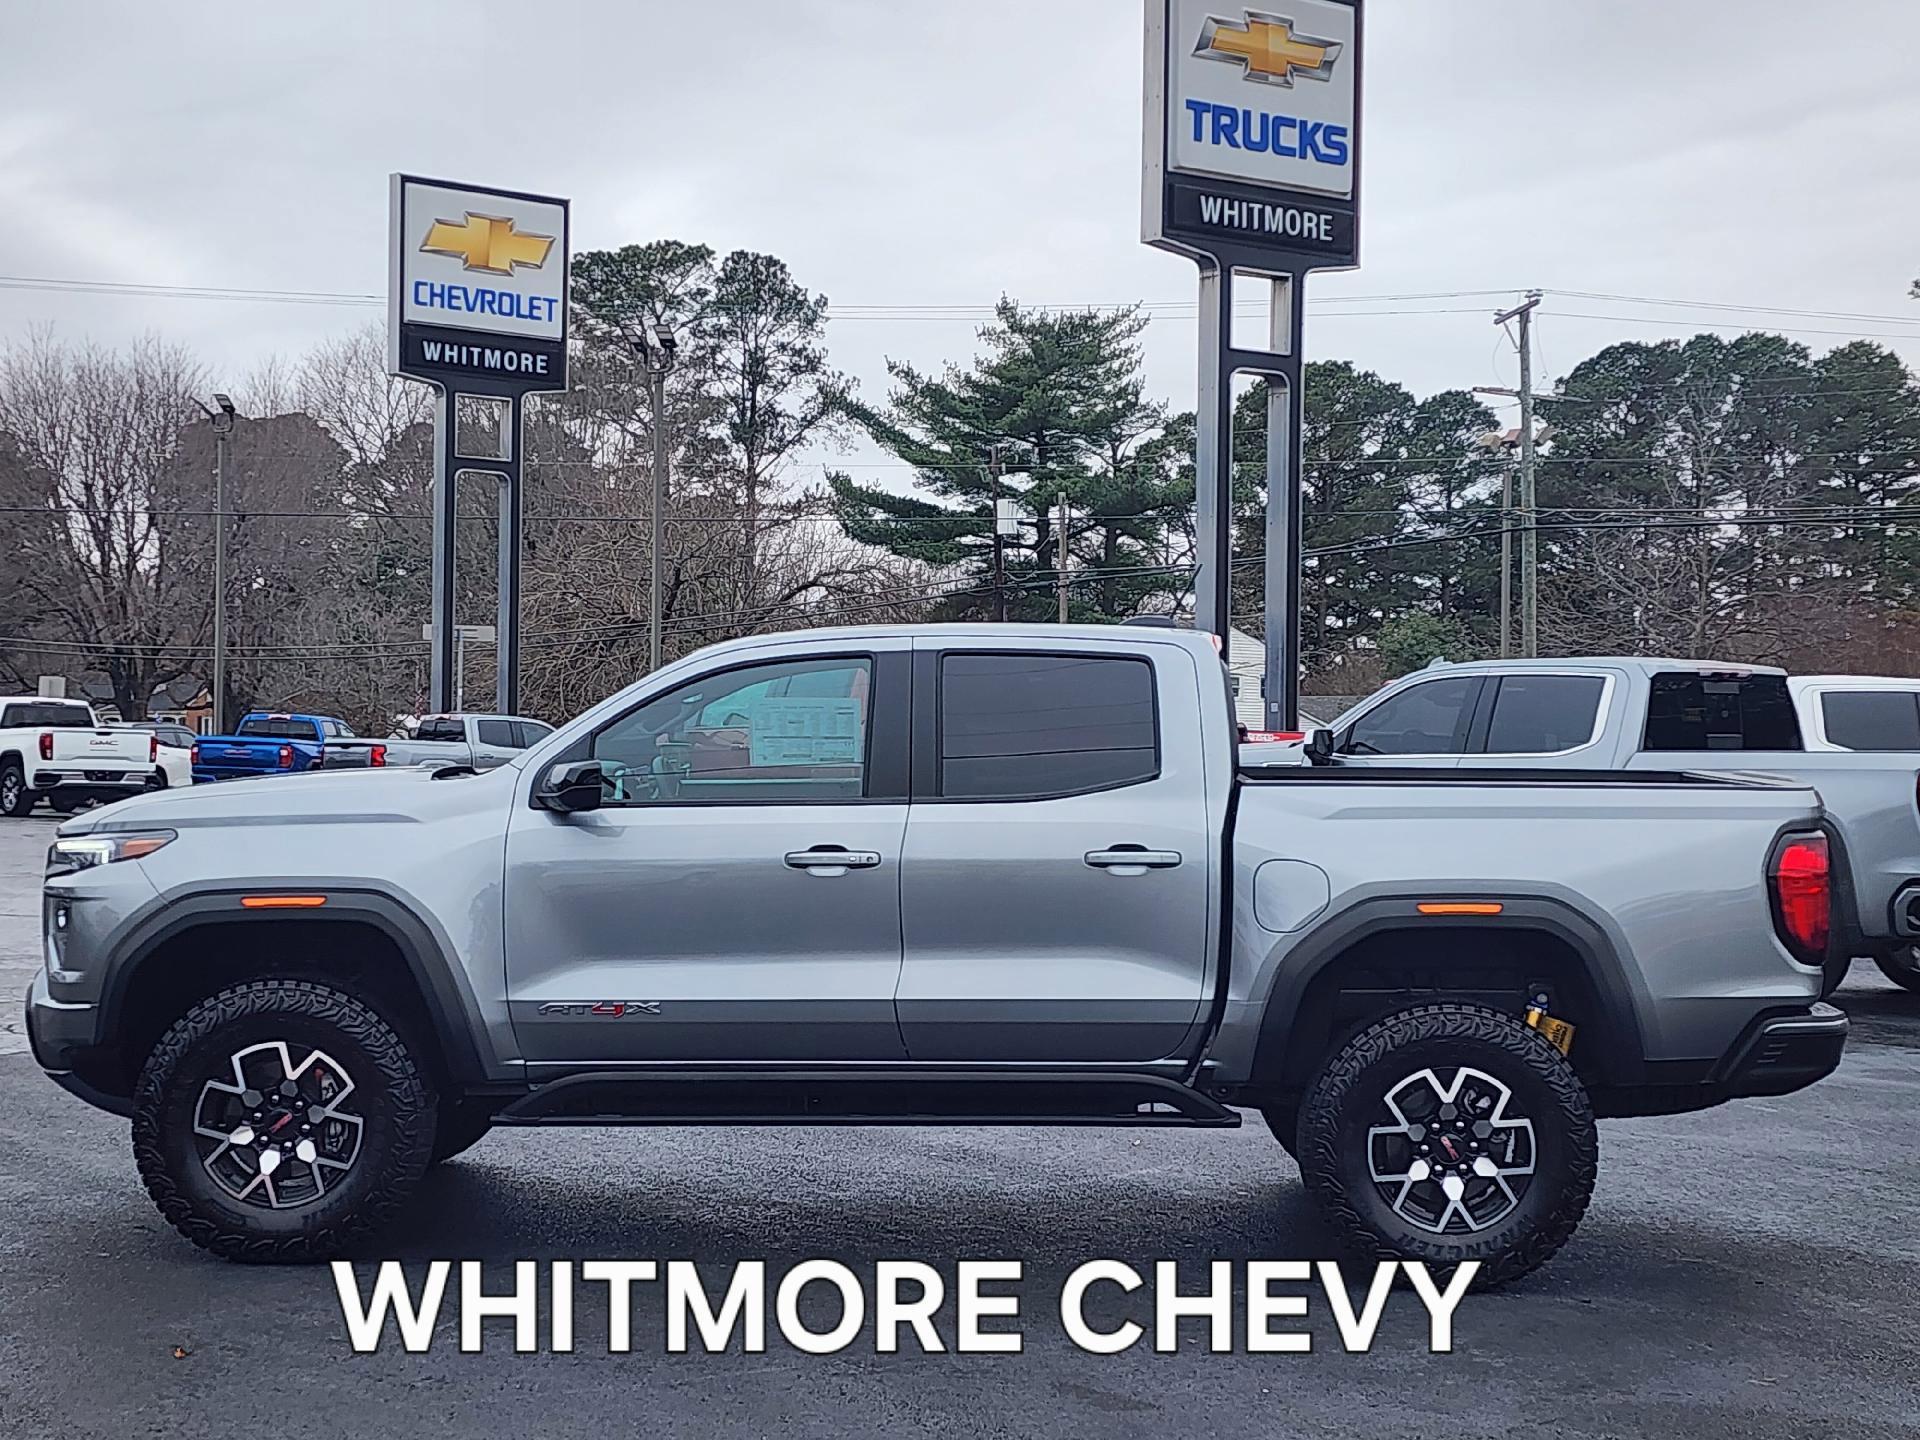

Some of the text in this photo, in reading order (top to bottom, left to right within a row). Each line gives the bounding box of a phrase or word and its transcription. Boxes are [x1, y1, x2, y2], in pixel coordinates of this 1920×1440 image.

[1185, 98, 1349, 166] TRUCKS
[1200, 194, 1334, 242] WHITMORE
[413, 280, 559, 323] CHEVROLET
[422, 340, 549, 374] WHITMORE
[538, 1001, 661, 1018] AT4X
